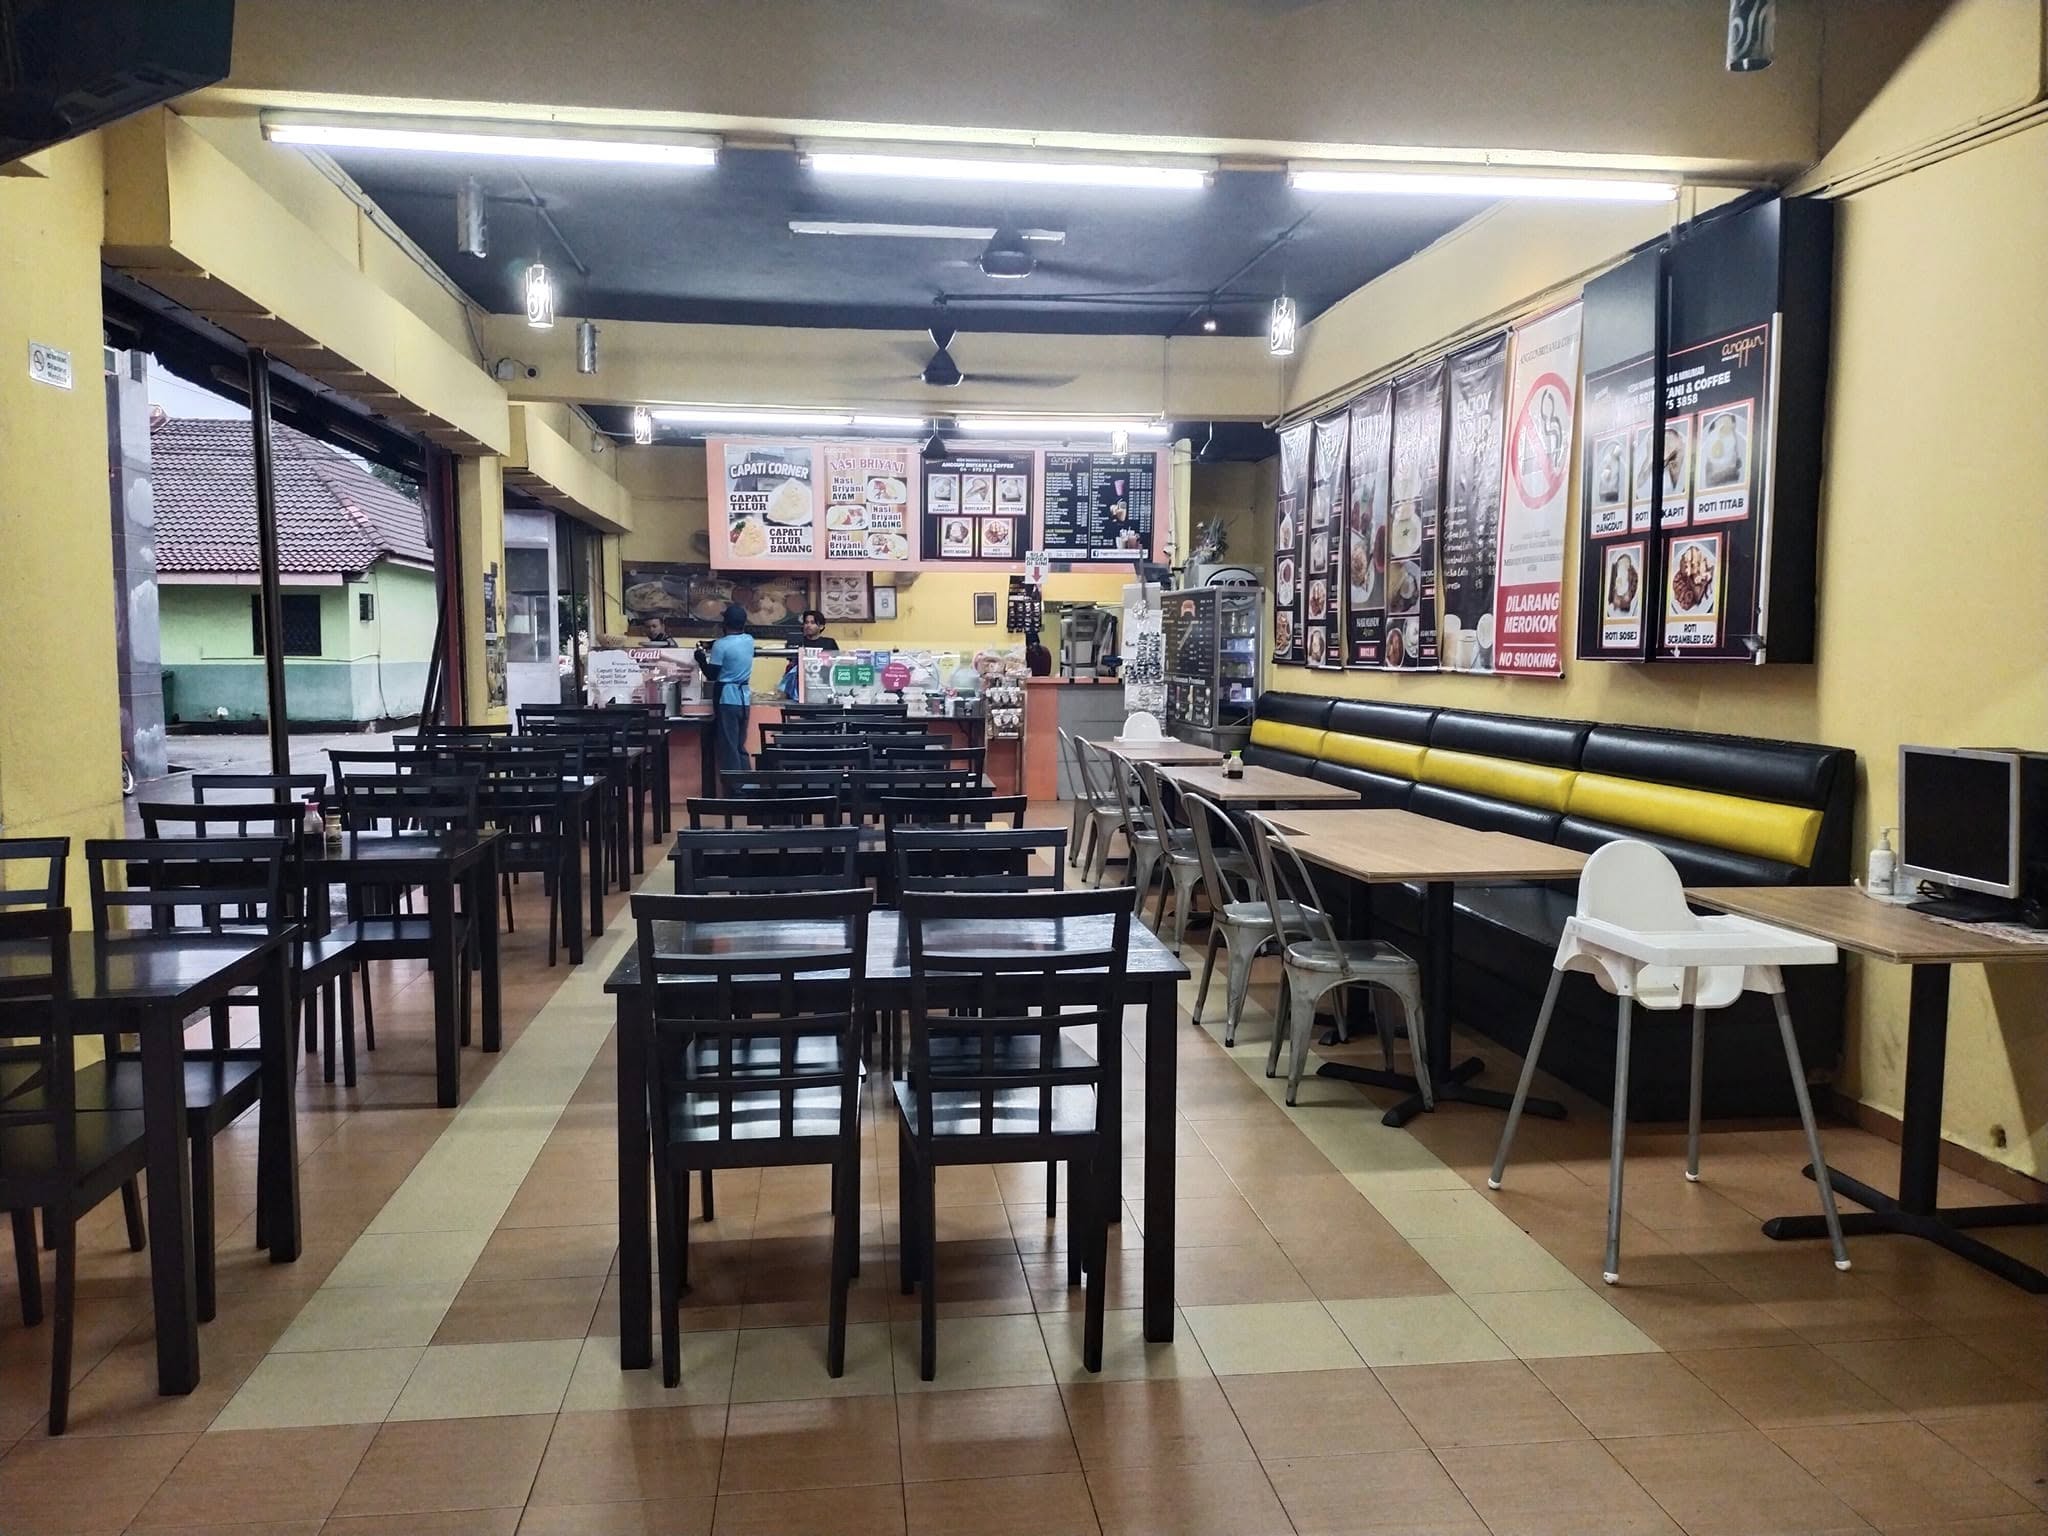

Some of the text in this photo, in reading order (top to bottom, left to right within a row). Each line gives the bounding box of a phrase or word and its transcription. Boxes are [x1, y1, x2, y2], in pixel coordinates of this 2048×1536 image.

[1686, 382, 1693, 394] &
[1694, 371, 1731, 391] COFFEE
[730, 462, 809, 479] CAPATI CORNER
[860, 459, 904, 473] BRIYANI
[730, 494, 769, 502] CAPATI
[730, 503, 767, 511] TELUR
[1698, 498, 1744, 512] ROTI TITAB
[871, 513, 901, 521] Briyani
[1603, 512, 1616, 521] ROTI
[1635, 507, 1685, 522] ROTI KAPIT
[769, 528, 803, 536] CAPATI
[1596, 521, 1623, 533] DANGDUT
[770, 545, 812, 553] BAWANG
[1505, 592, 1560, 613] DILARANG
[1503, 614, 1557, 634] MEROKOK
[1683, 623, 1697, 633] ROTI
[1605, 631, 1637, 641] ROTI SOSEJ
[1667, 634, 1714, 645] SCRAMBLED EGG
[628, 648, 661, 661] Capati
[1499, 651, 1557, 669] NO SMOKING
